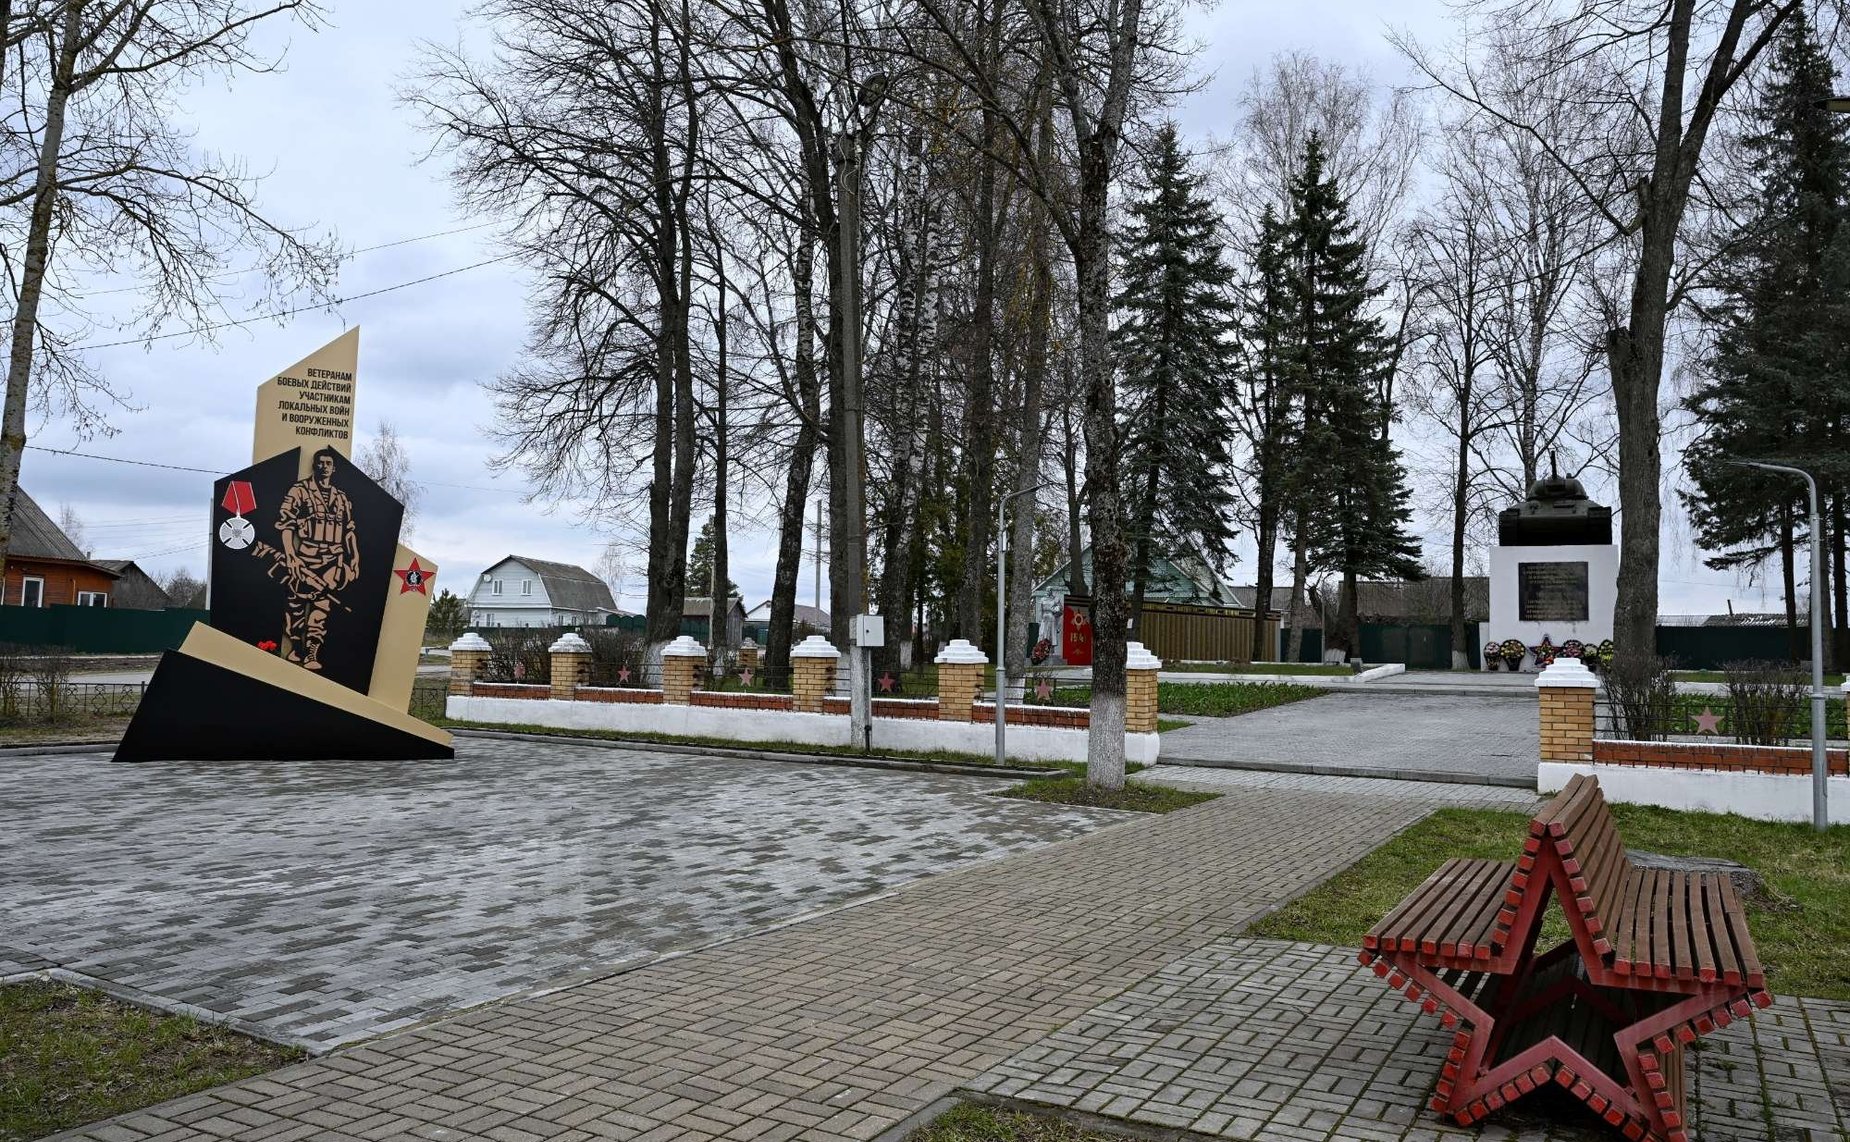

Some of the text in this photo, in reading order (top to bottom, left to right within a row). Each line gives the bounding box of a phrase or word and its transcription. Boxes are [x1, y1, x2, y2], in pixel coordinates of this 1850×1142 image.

[307, 368, 352, 381] ВЕТЕРАНАМ
[277, 376, 352, 393] БОЕВЫХ ДЕЙСТВИЙ
[298, 391, 351, 404] УЧАСТНИКАМ
[278, 400, 350, 416] ЛОКАЛЬНЫХ ВОЙН
[281, 412, 349, 427] И ВООРУЖЕННЫХ
[295, 426, 349, 439] КОНФЛИКТОВ
